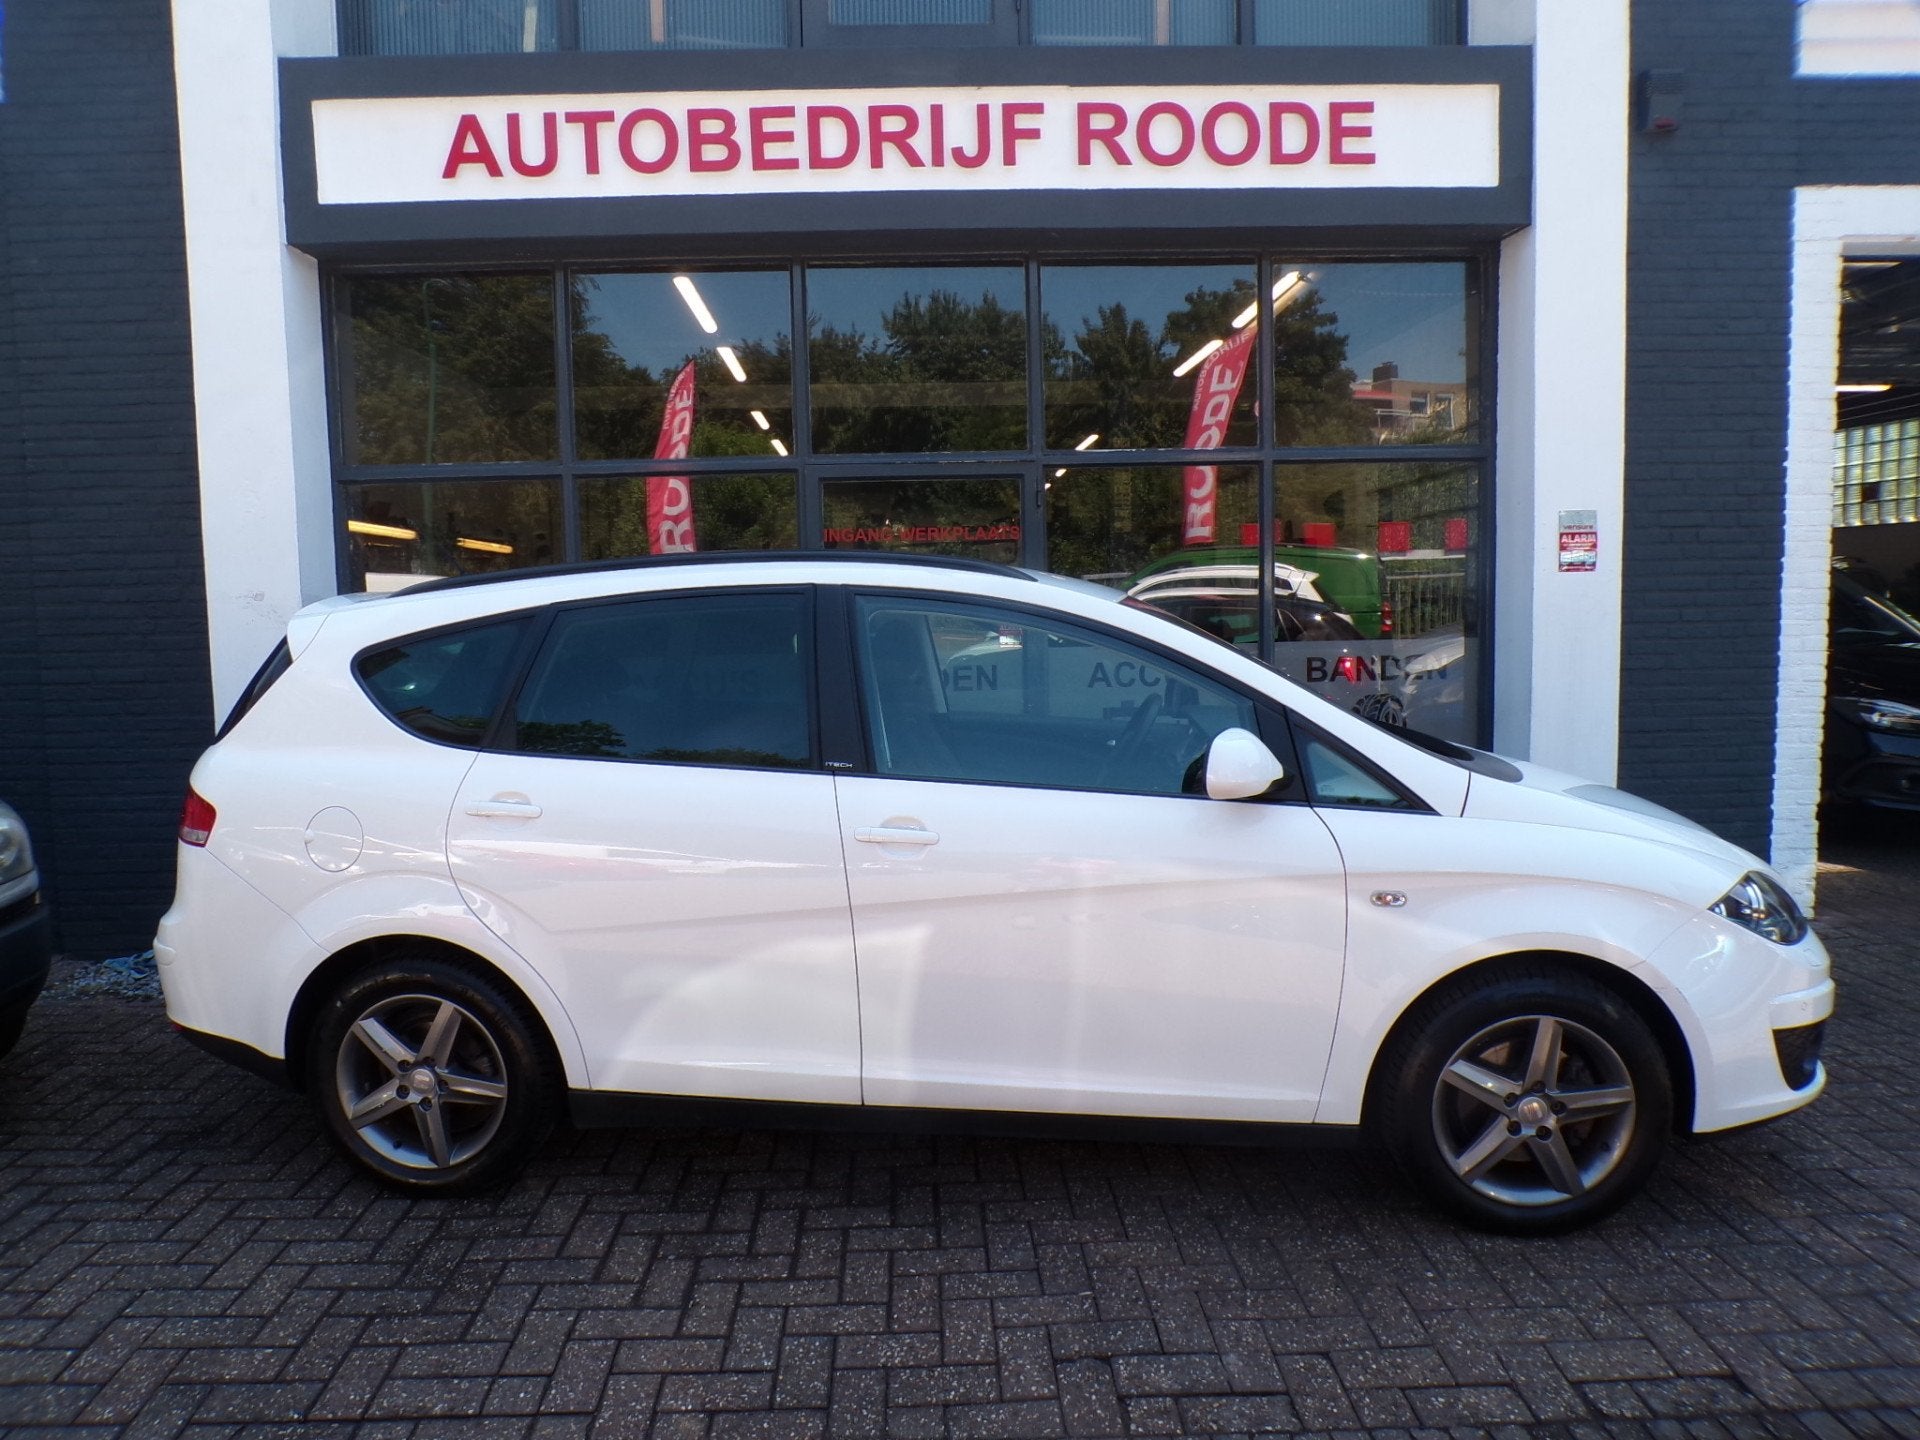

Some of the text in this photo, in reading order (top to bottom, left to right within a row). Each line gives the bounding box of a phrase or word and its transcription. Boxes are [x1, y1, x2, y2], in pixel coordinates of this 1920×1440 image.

[443, 101, 1375, 179] AUTOBEDRIJF ROODE
[823, 525, 1021, 543] INGANG WERKPLAATS
[1560, 534, 1597, 543] ALARM
